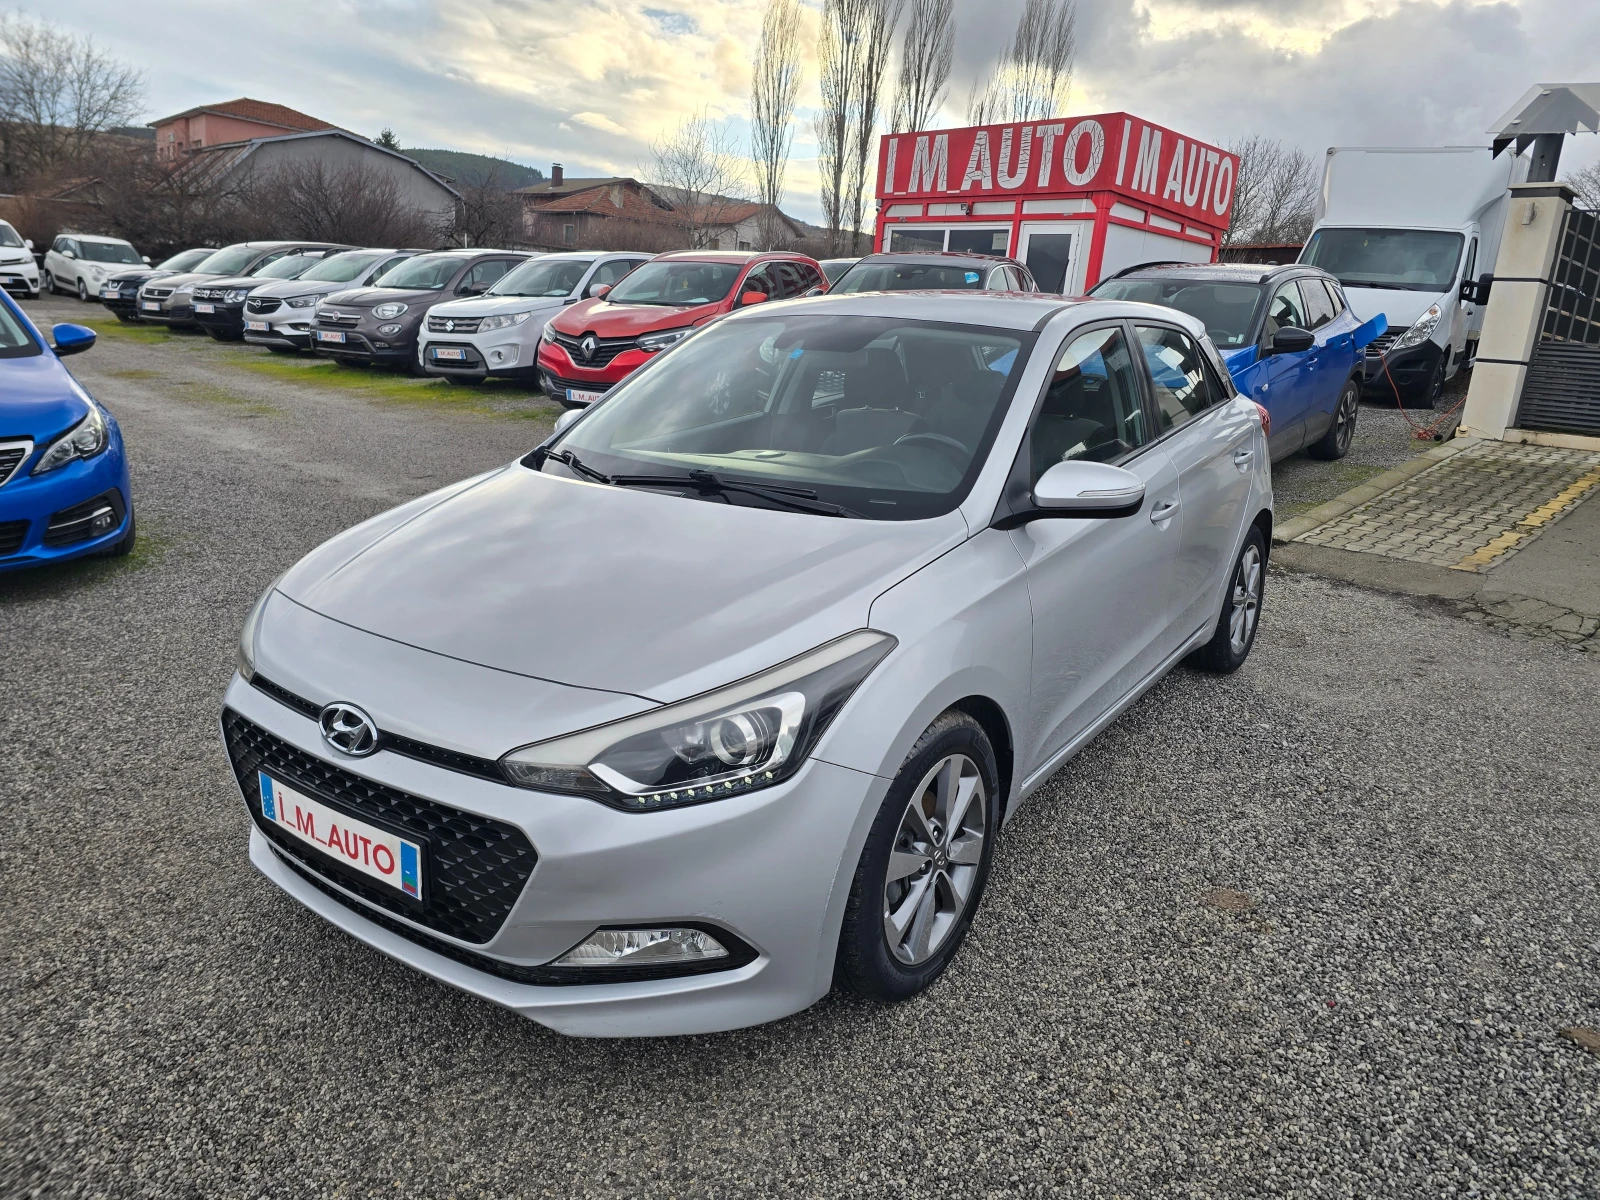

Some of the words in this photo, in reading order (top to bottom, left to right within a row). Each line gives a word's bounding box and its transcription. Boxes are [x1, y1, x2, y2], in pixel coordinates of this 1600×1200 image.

[1115, 119, 1131, 186] I
[1131, 125, 1162, 195] M
[1163, 138, 1233, 216] AUTO
